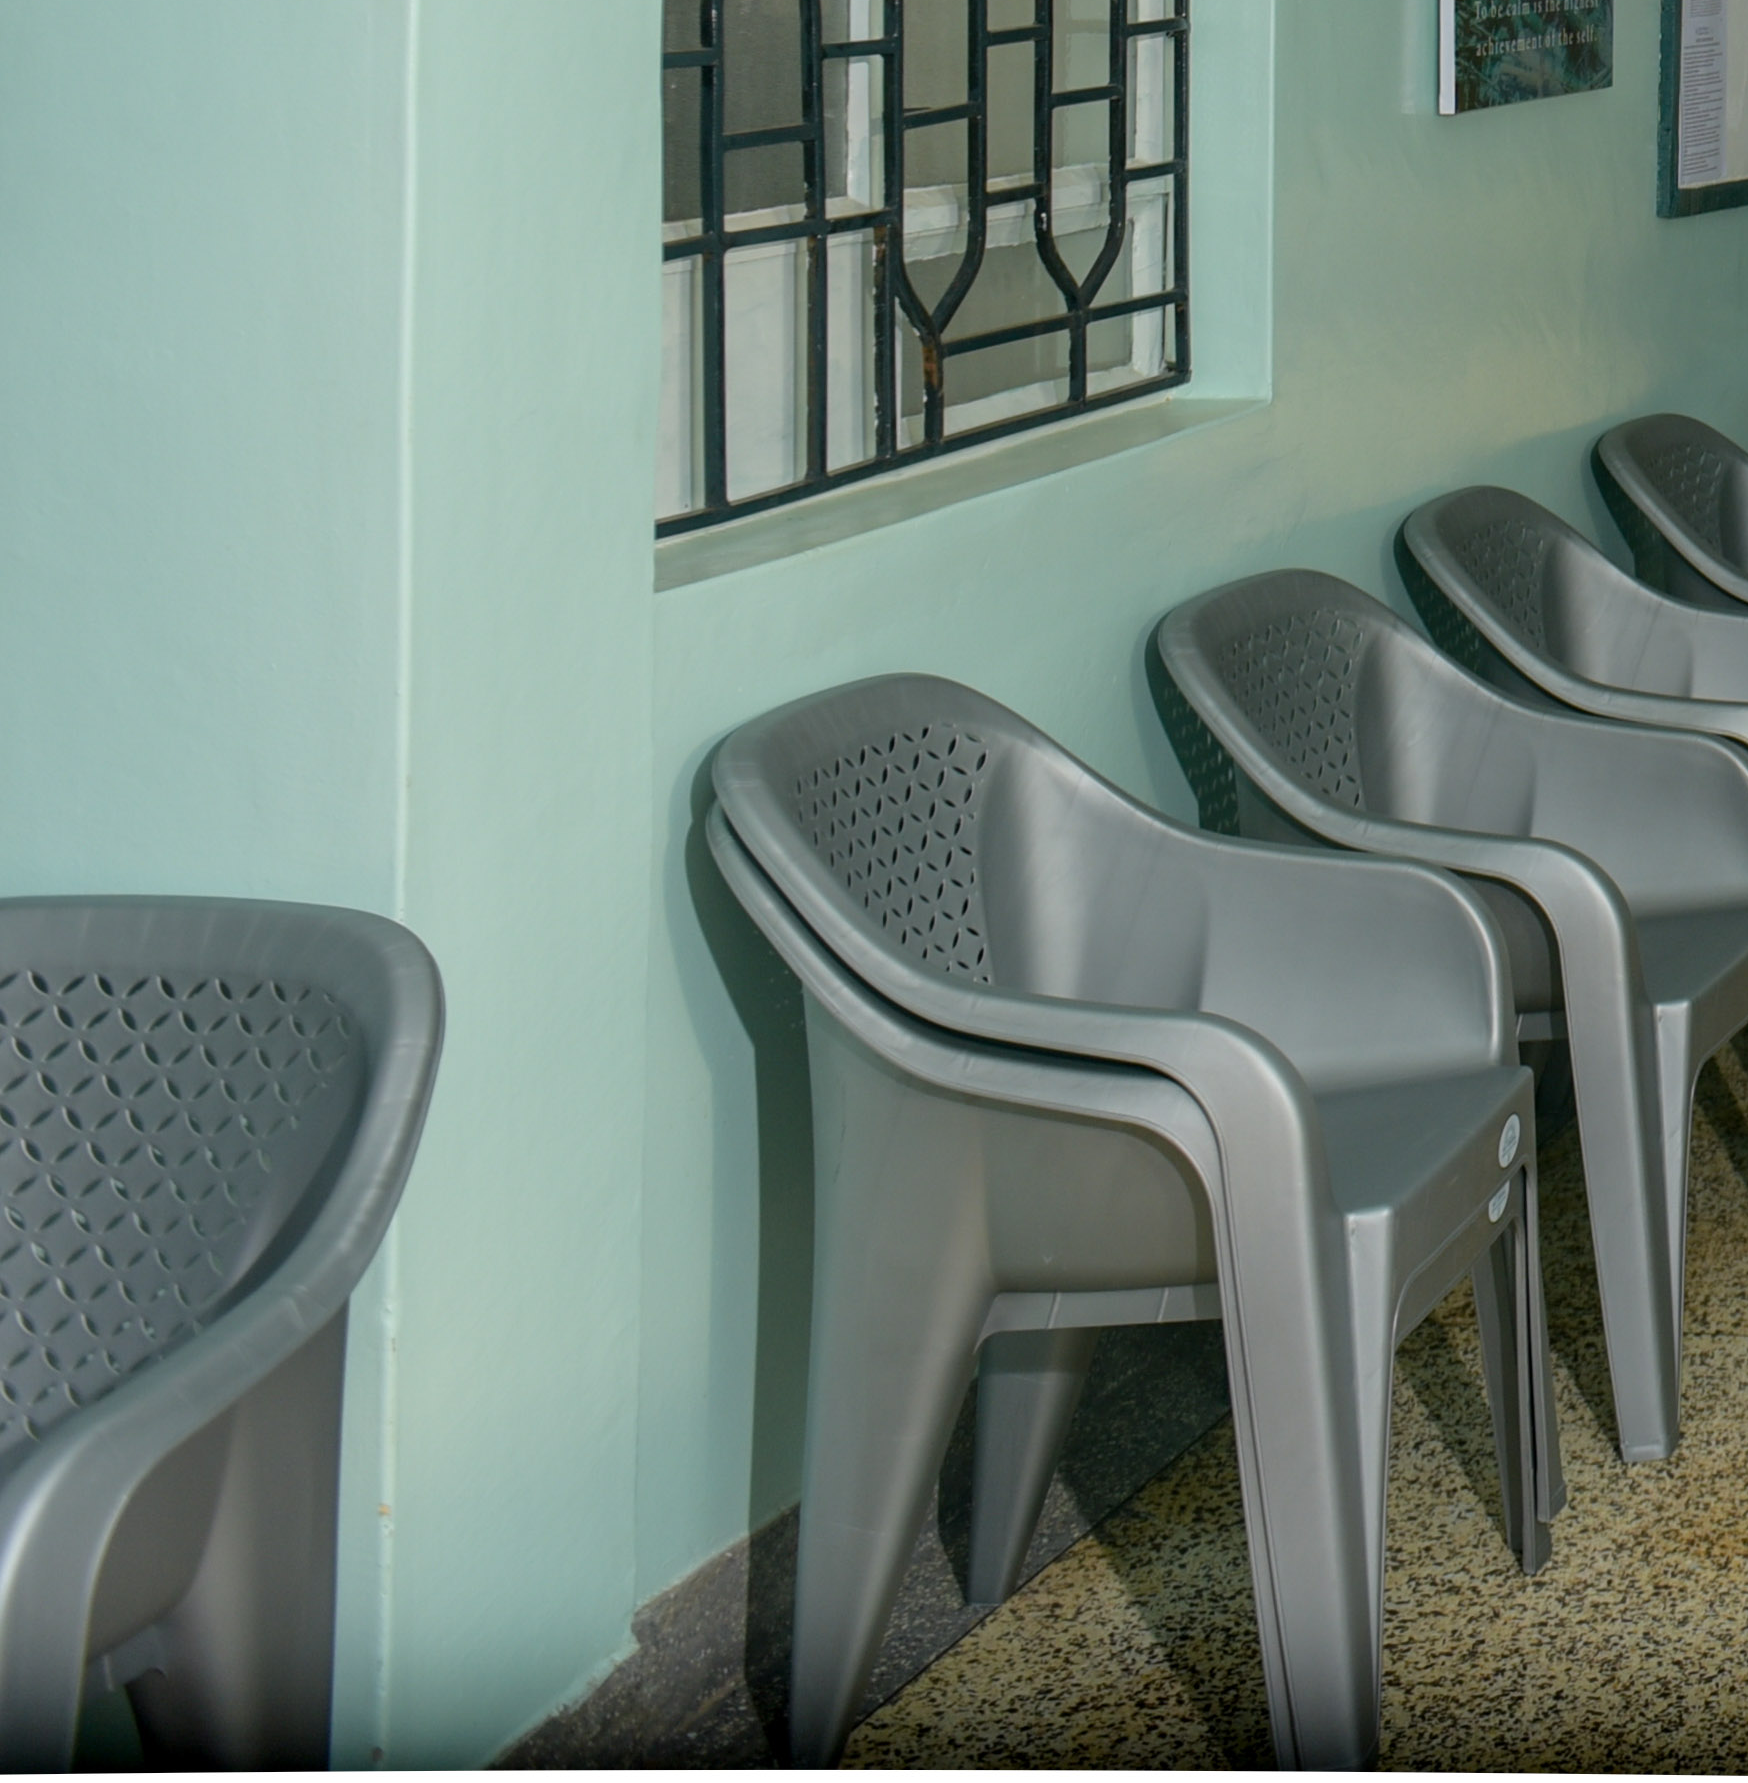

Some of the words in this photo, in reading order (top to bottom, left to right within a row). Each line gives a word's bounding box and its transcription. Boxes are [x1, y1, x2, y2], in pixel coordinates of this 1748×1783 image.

[1473, 0, 1488, 19] To
[1490, 0, 1504, 18] be
[1475, 35, 1543, 57] achievement
[1544, 28, 1556, 48] of
[1556, 27, 1573, 46] the
